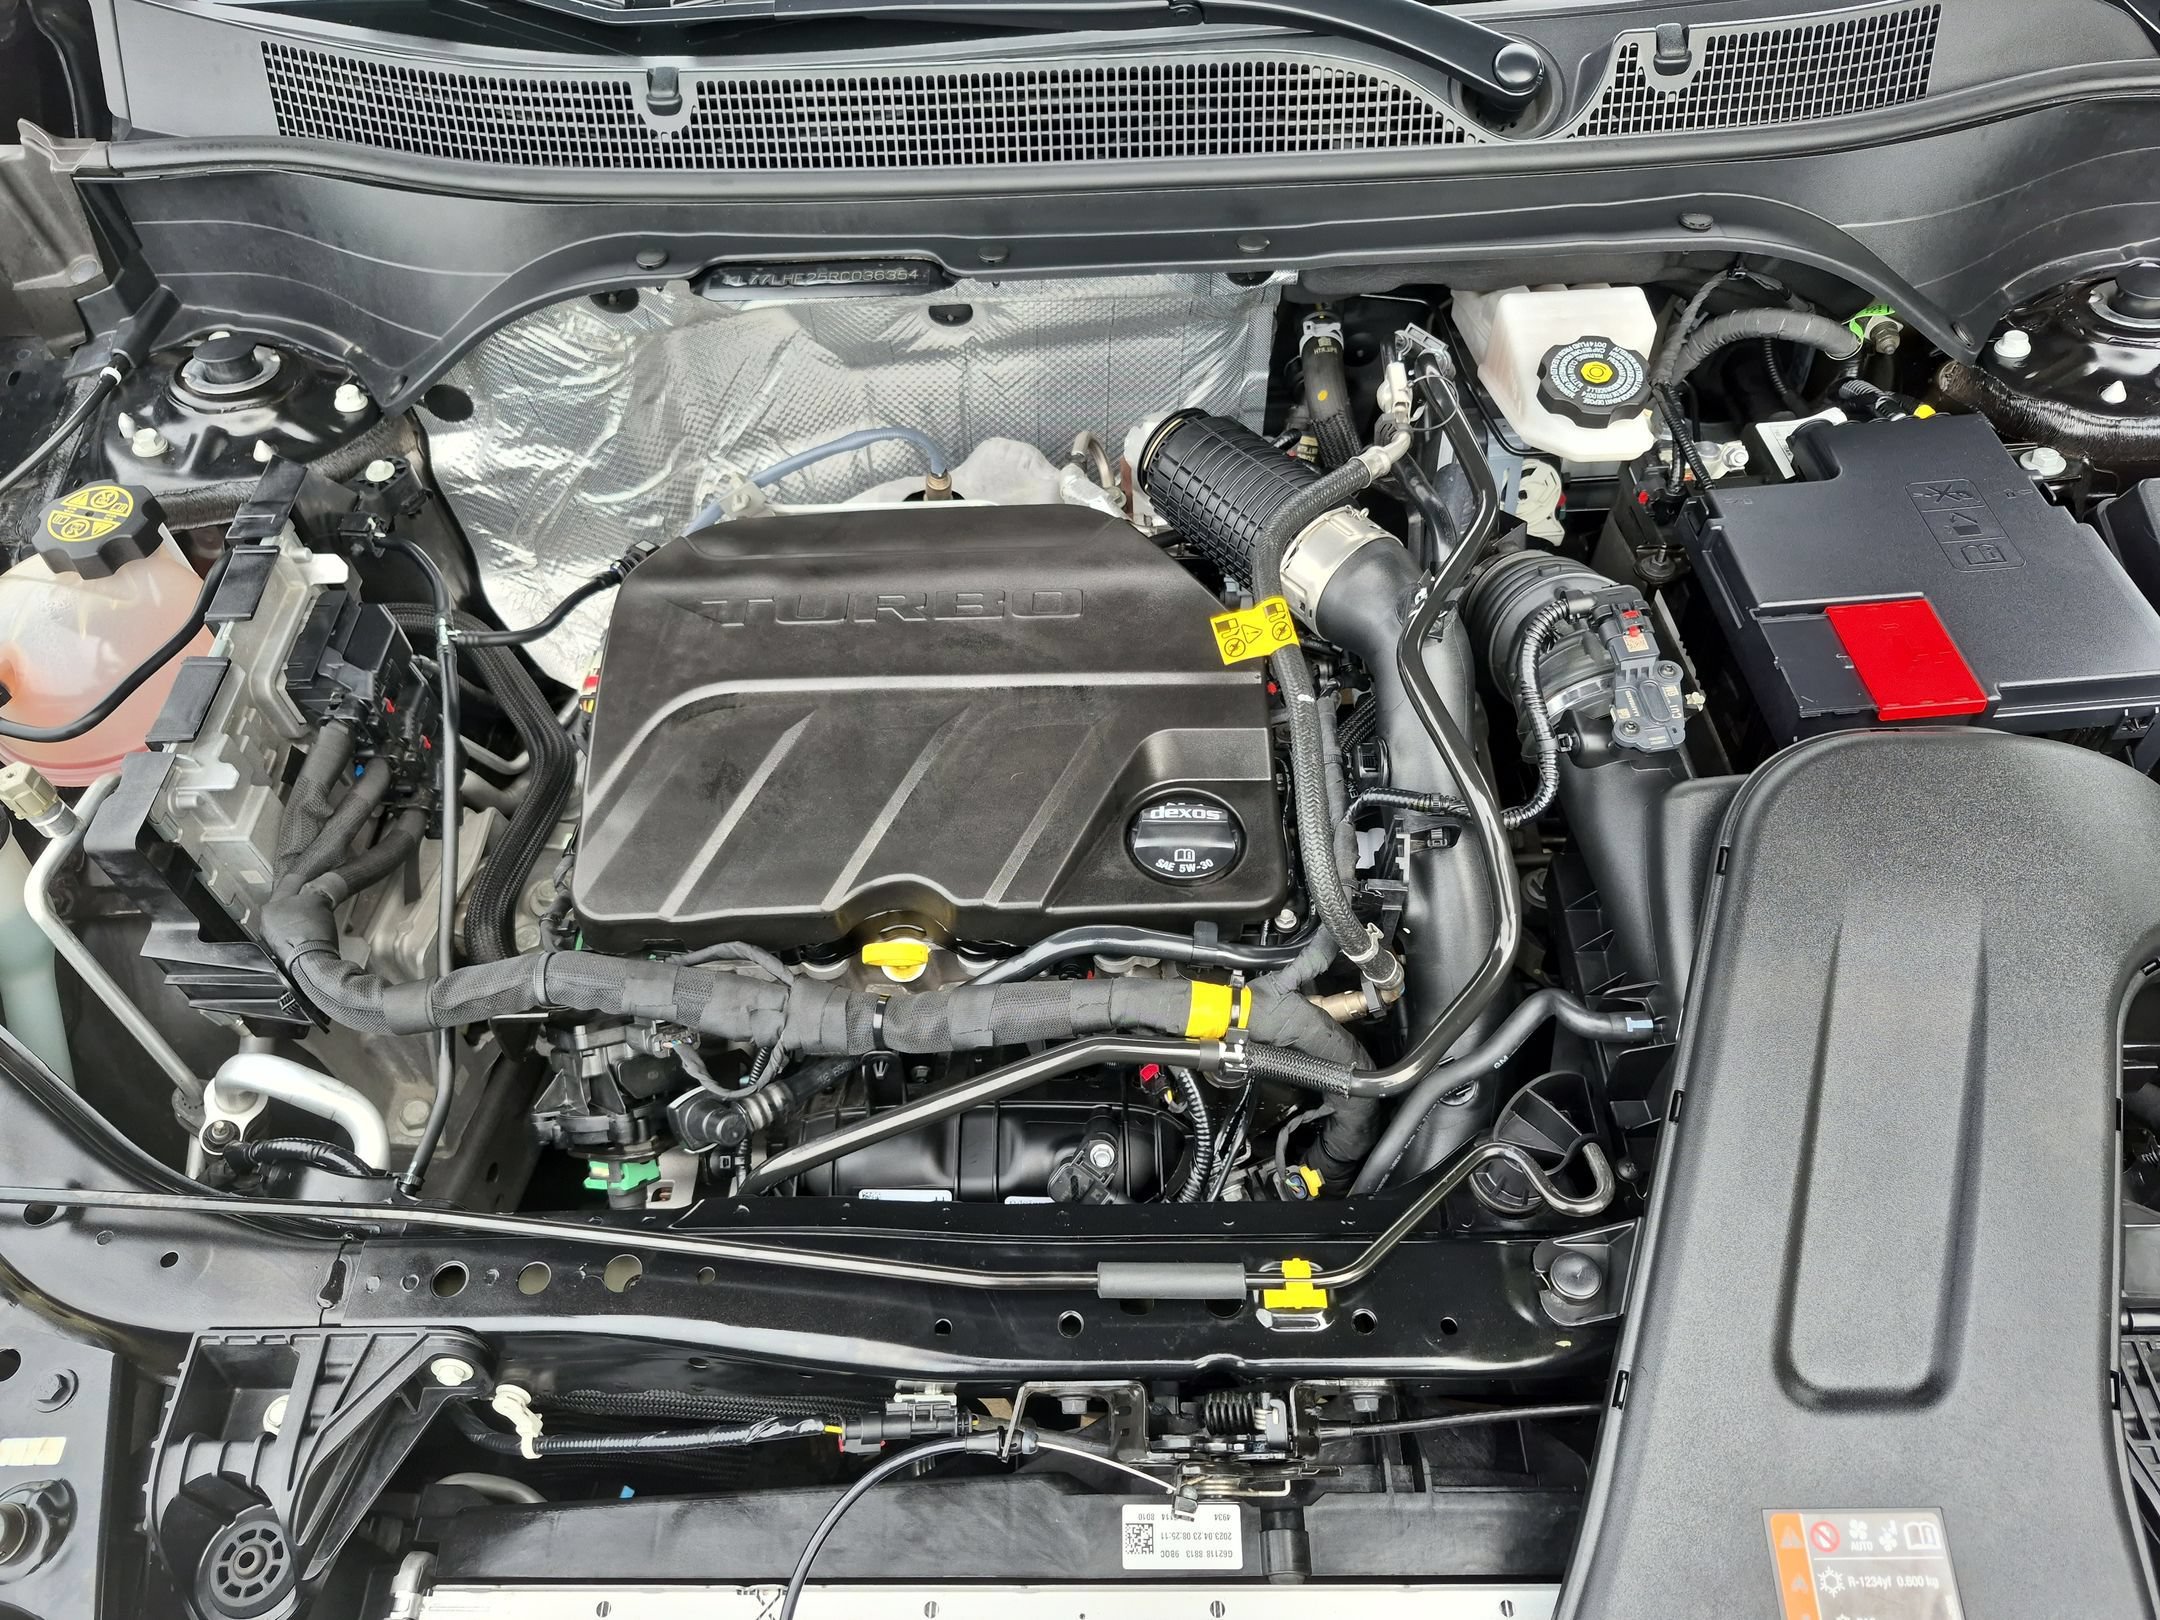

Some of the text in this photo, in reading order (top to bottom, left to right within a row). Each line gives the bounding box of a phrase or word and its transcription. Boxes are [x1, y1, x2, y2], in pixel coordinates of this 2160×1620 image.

[701, 588, 1083, 627] TURBO
[1150, 806, 1222, 820] dexos
[1155, 858, 1214, 873] SAE 5W-30
[1161, 1532, 1232, 1541] 2023.04.23 08:25:11
[1850, 1540, 1873, 1552] AUTO
